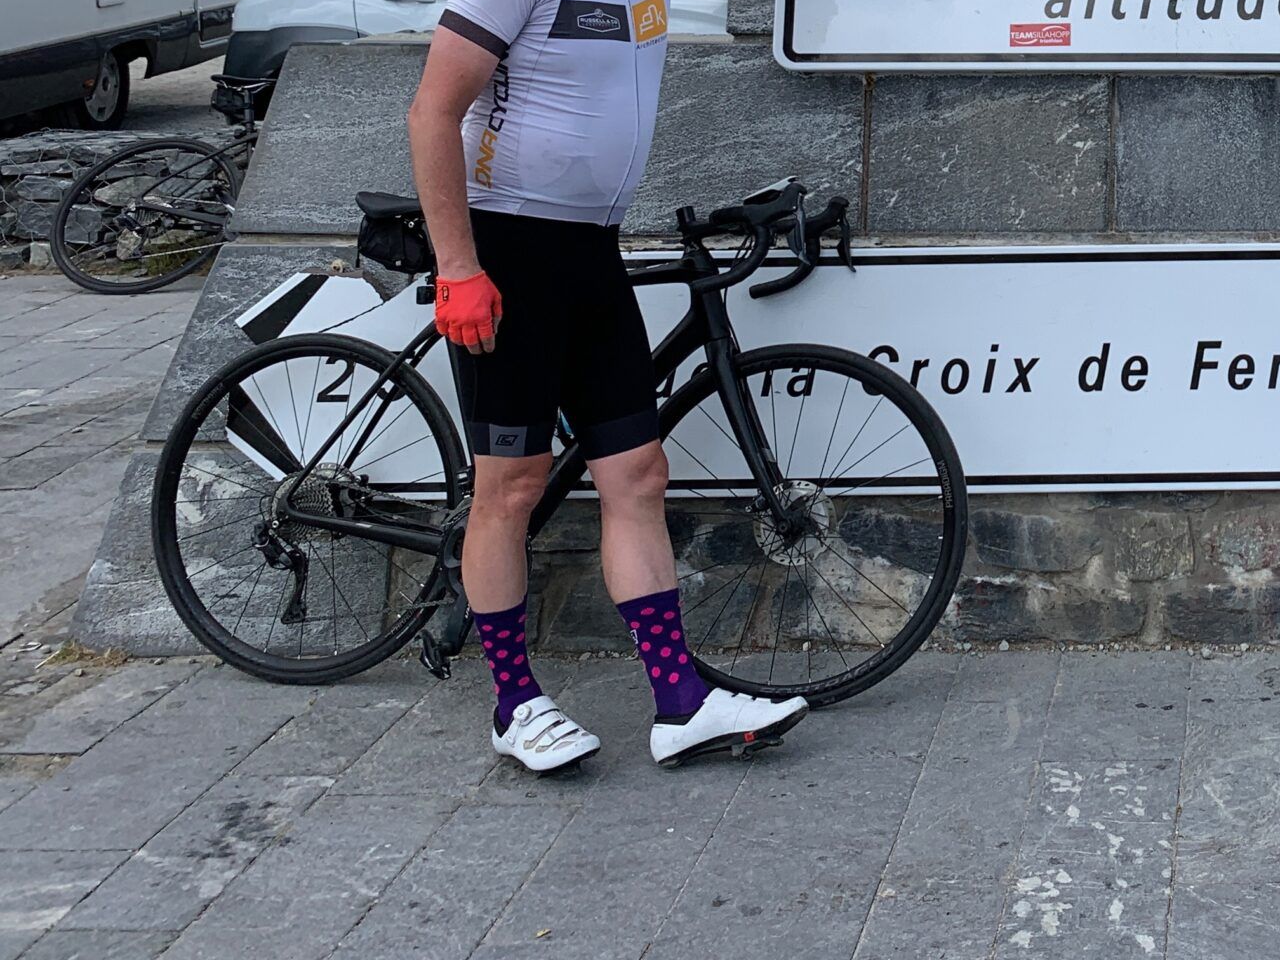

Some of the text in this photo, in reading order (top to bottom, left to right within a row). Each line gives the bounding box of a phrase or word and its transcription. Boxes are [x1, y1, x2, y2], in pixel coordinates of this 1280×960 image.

[475, 128, 498, 189] DNA
[1079, 343, 1148, 392] de
[937, 461, 953, 509] PARADIGM
